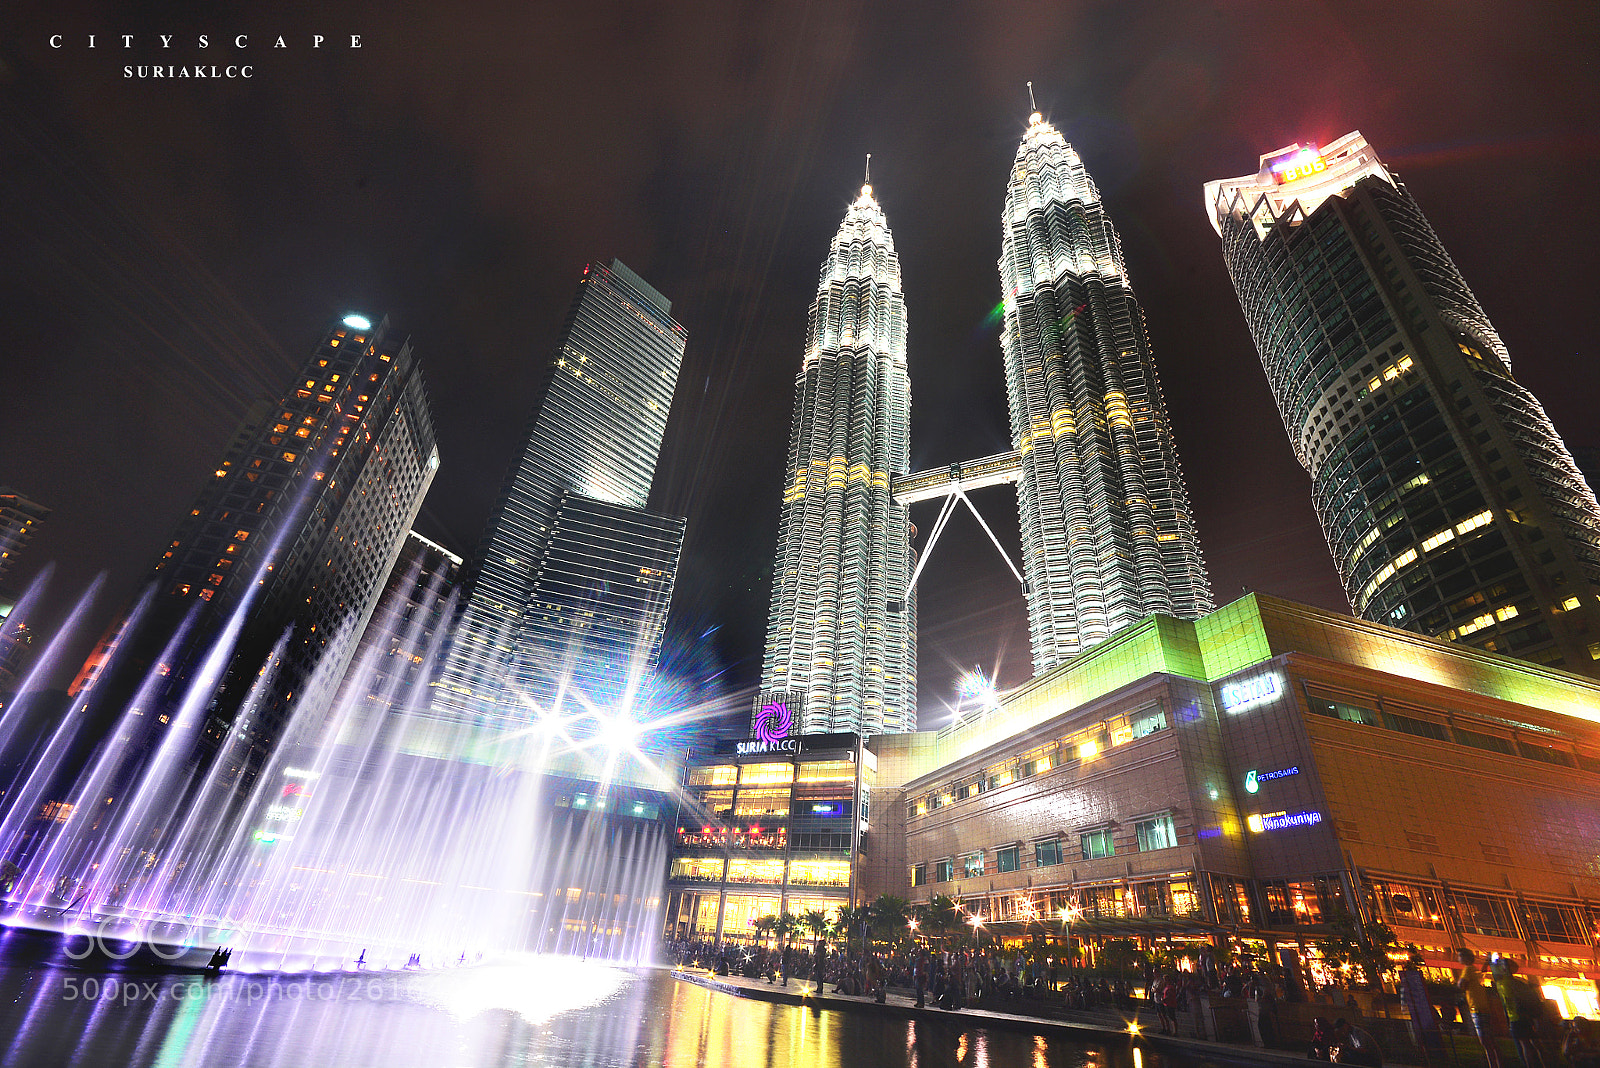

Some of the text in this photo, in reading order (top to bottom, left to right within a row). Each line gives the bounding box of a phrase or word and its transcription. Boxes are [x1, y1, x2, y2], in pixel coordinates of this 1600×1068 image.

[736, 739, 796, 755] SURIA KLCC
[1257, 766, 1299, 783] PETROSAINS
[1263, 811, 1322, 831] Kinokuniya
